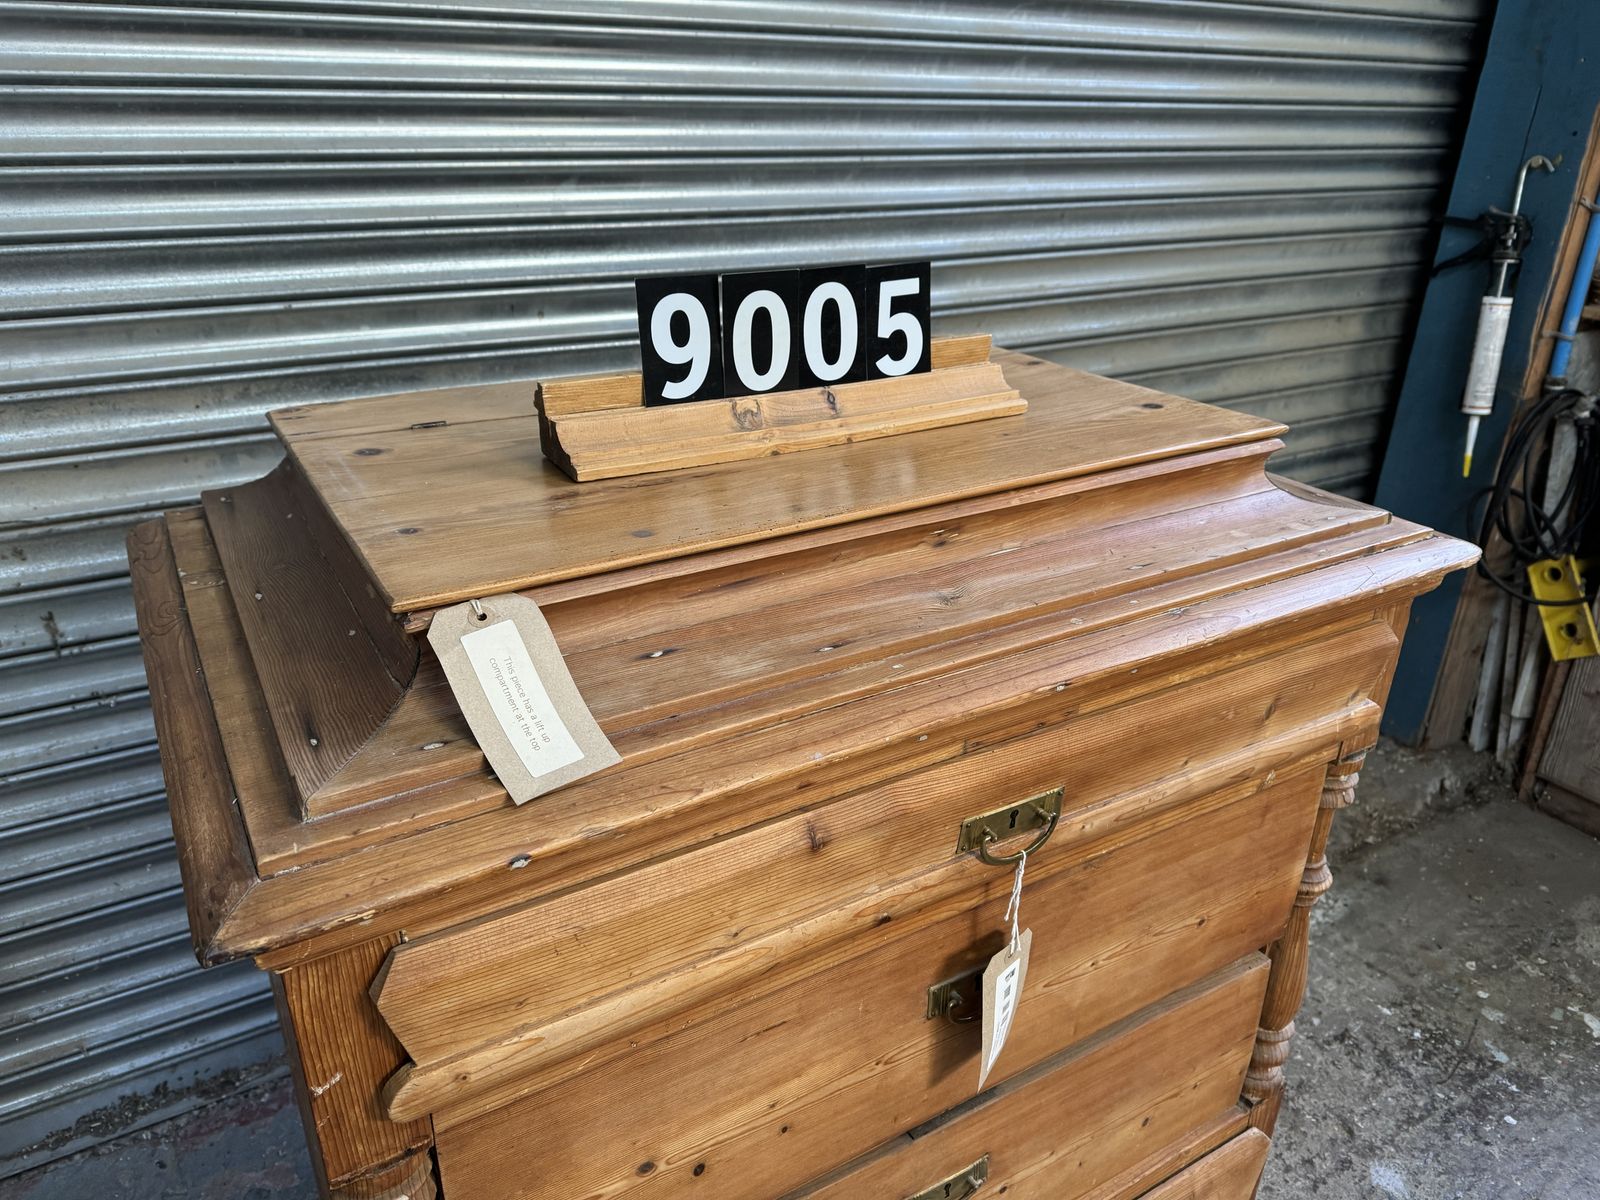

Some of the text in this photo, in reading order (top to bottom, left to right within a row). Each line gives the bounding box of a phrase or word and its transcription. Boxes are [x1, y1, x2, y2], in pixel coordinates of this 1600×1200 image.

[650, 277, 923, 400] 9005
[489, 657, 541, 751] compartment at the top
[503, 656, 515, 674] This
[510, 673, 526, 698] piece
[523, 697, 534, 714] has
[535, 720, 545, 732] lift
[541, 732, 551, 743] up
